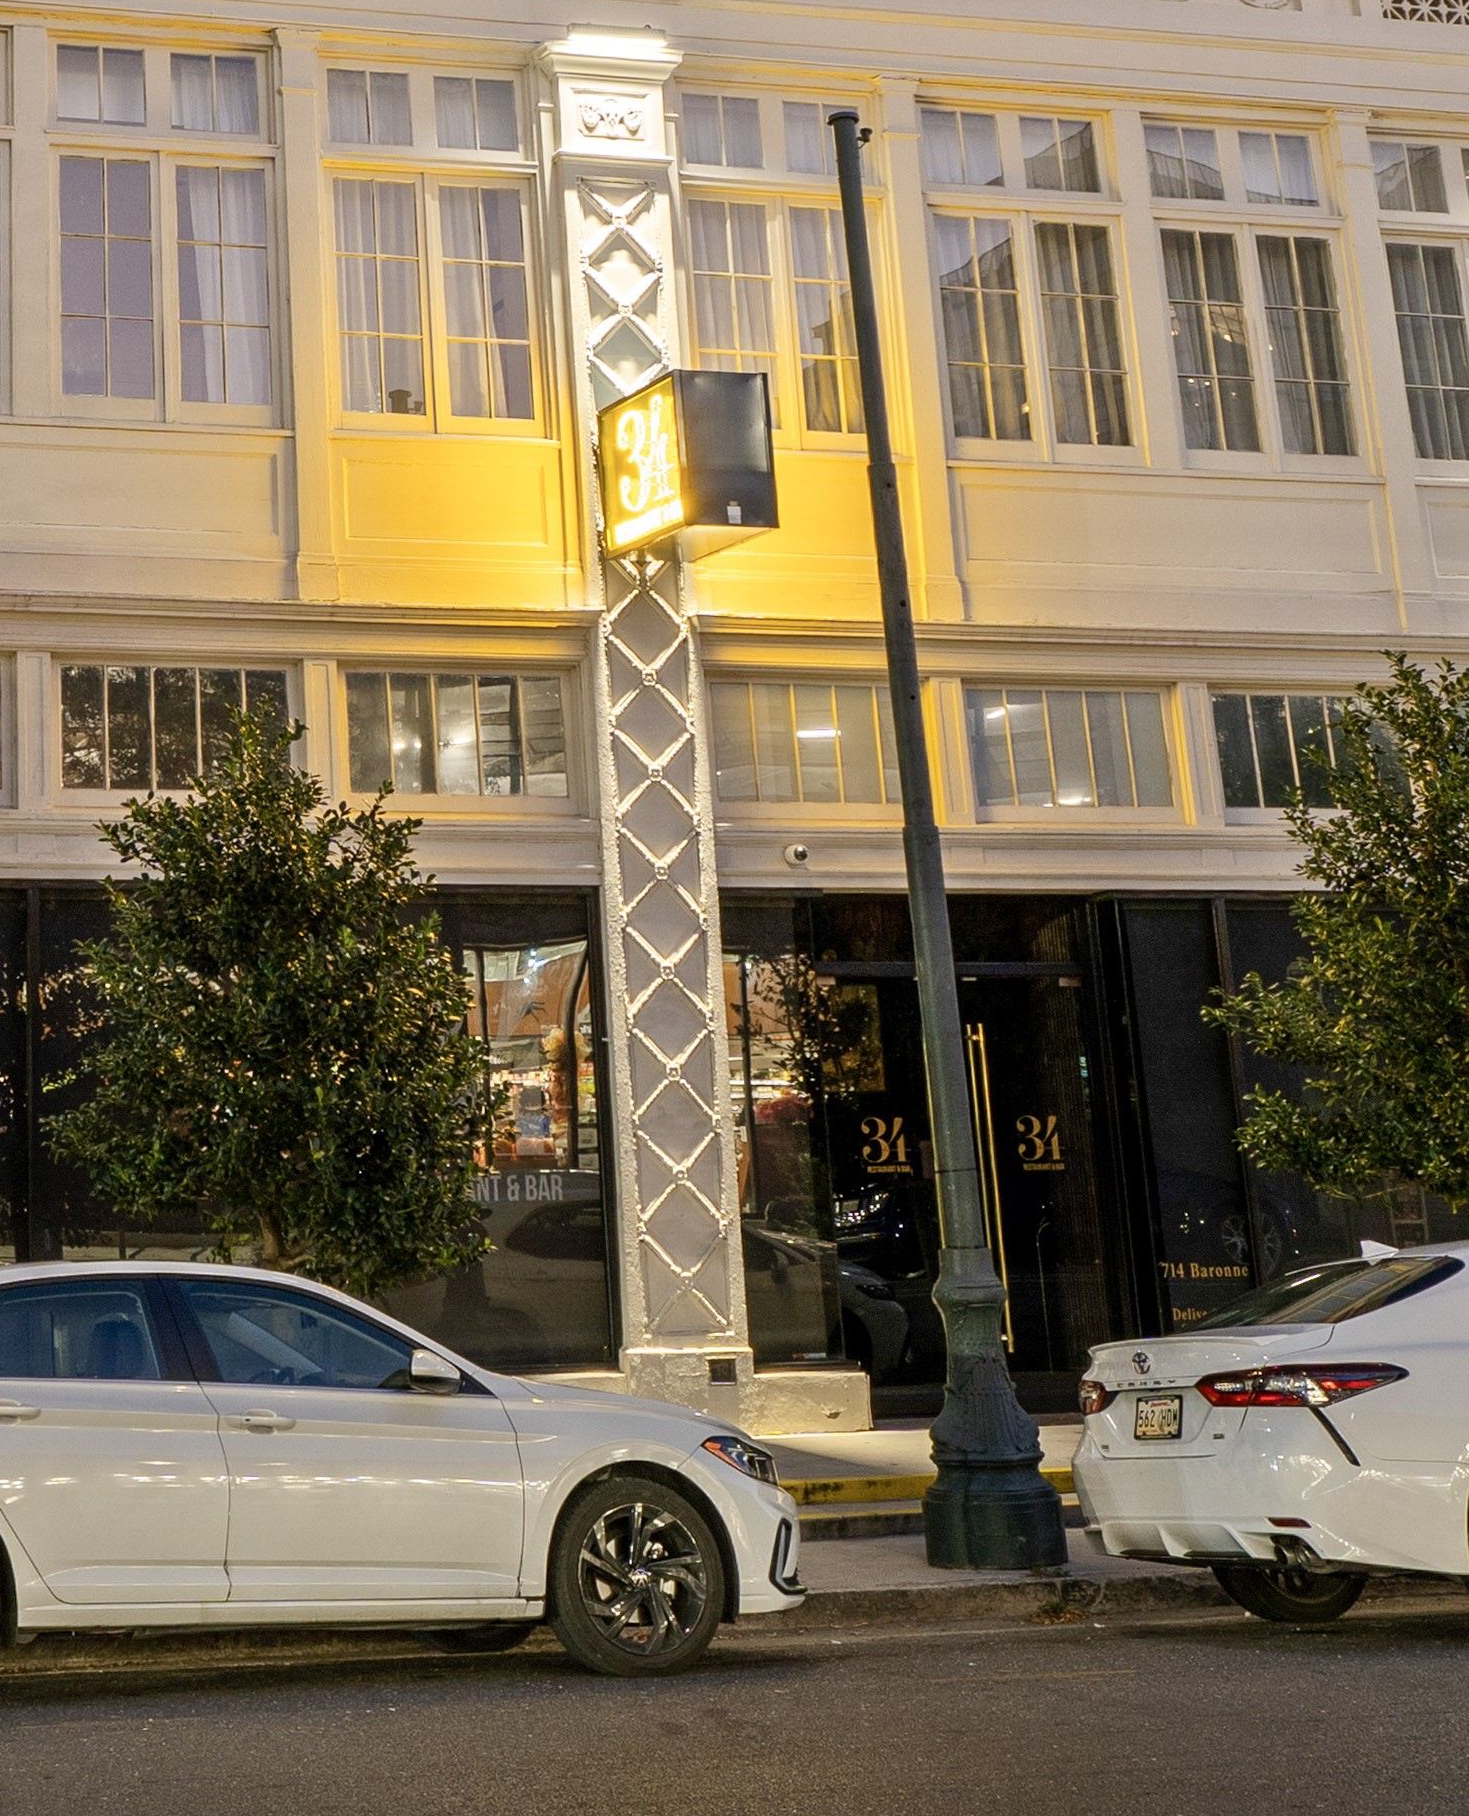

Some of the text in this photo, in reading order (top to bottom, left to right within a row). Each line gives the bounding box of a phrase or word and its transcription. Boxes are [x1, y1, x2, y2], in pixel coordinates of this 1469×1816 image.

[617, 394, 676, 512] 34
[861, 1116, 912, 1164] 34
[1016, 1114, 1066, 1161] 34
[506, 1175, 520, 1202] &
[524, 1174, 564, 1201] BAR
[1158, 1261, 1249, 1278] 714 Baronne
